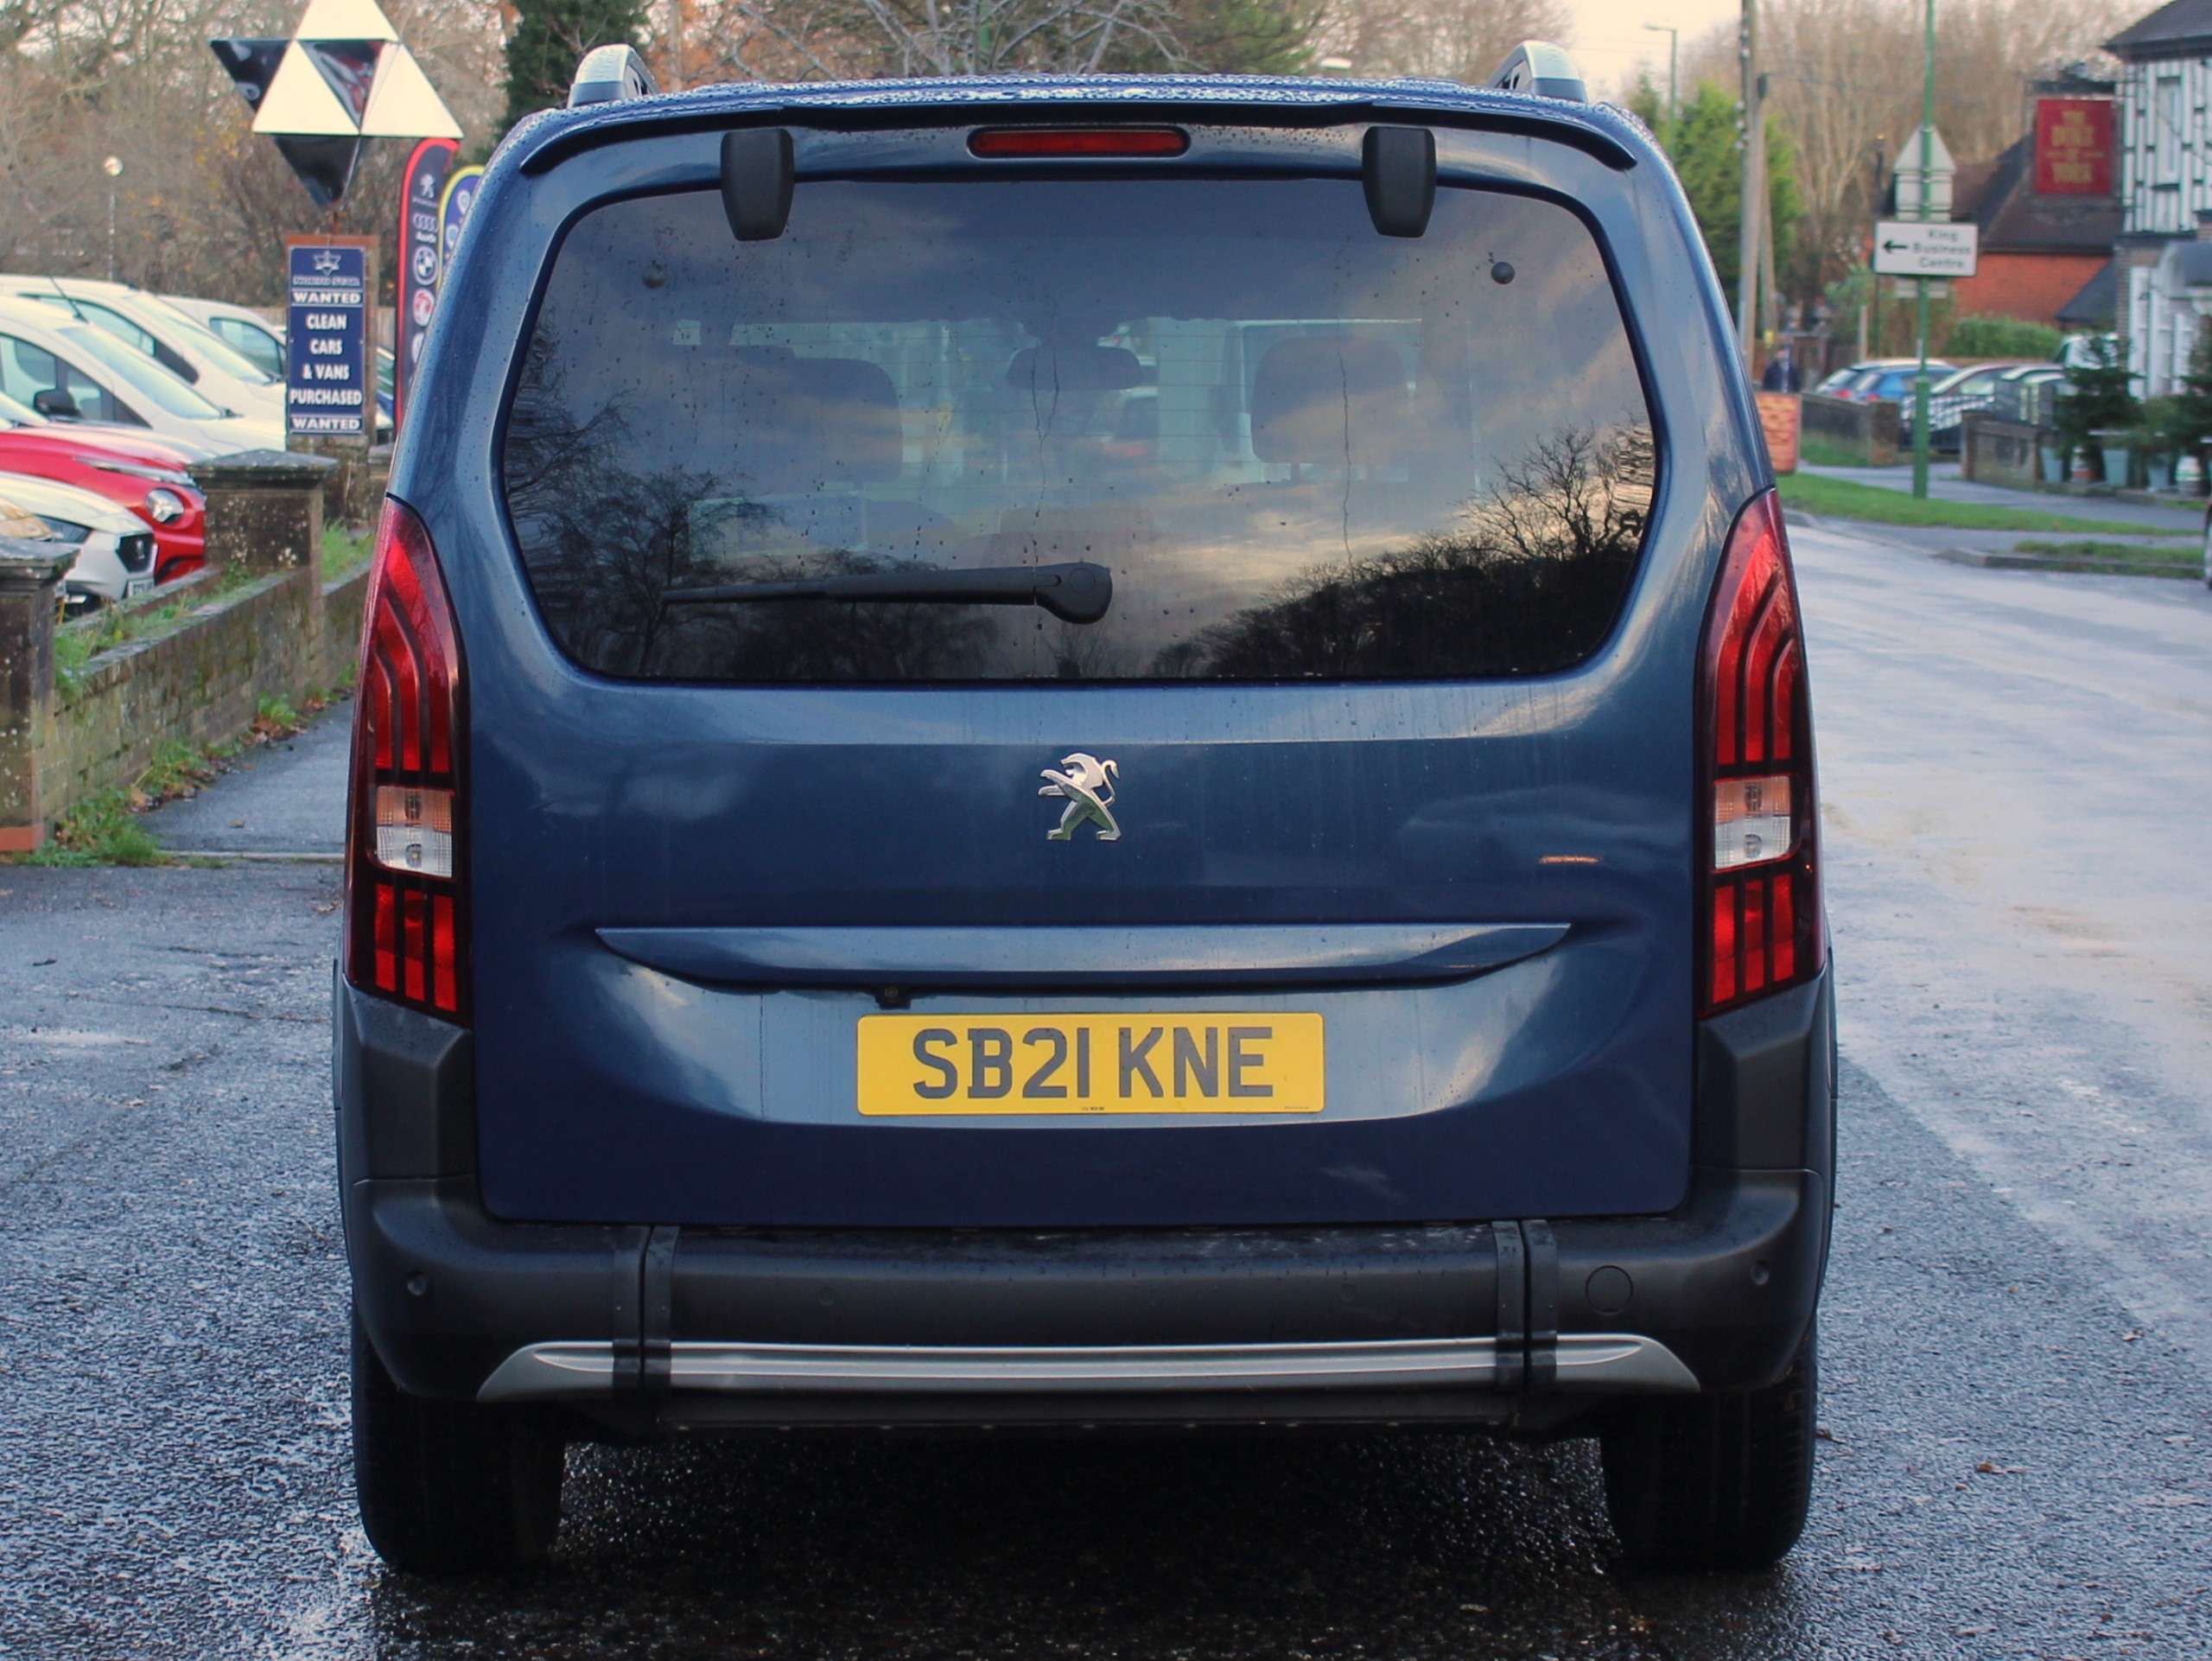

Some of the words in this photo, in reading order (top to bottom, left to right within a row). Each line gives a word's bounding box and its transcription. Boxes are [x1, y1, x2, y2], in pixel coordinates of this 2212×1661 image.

[1928, 229, 1959, 242] King
[1913, 243, 1971, 254] Business
[1920, 257, 1964, 268] Centre
[293, 291, 360, 304] WANTED
[307, 314, 347, 330] CLEAN
[310, 338, 343, 355] CARS
[302, 364, 313, 379] &
[315, 364, 350, 380] VANS
[289, 389, 362, 405] PURCHASED
[292, 417, 360, 430] WANTED
[912, 1027, 1090, 1099] SB21
[1118, 1026, 1274, 1098] KNE
